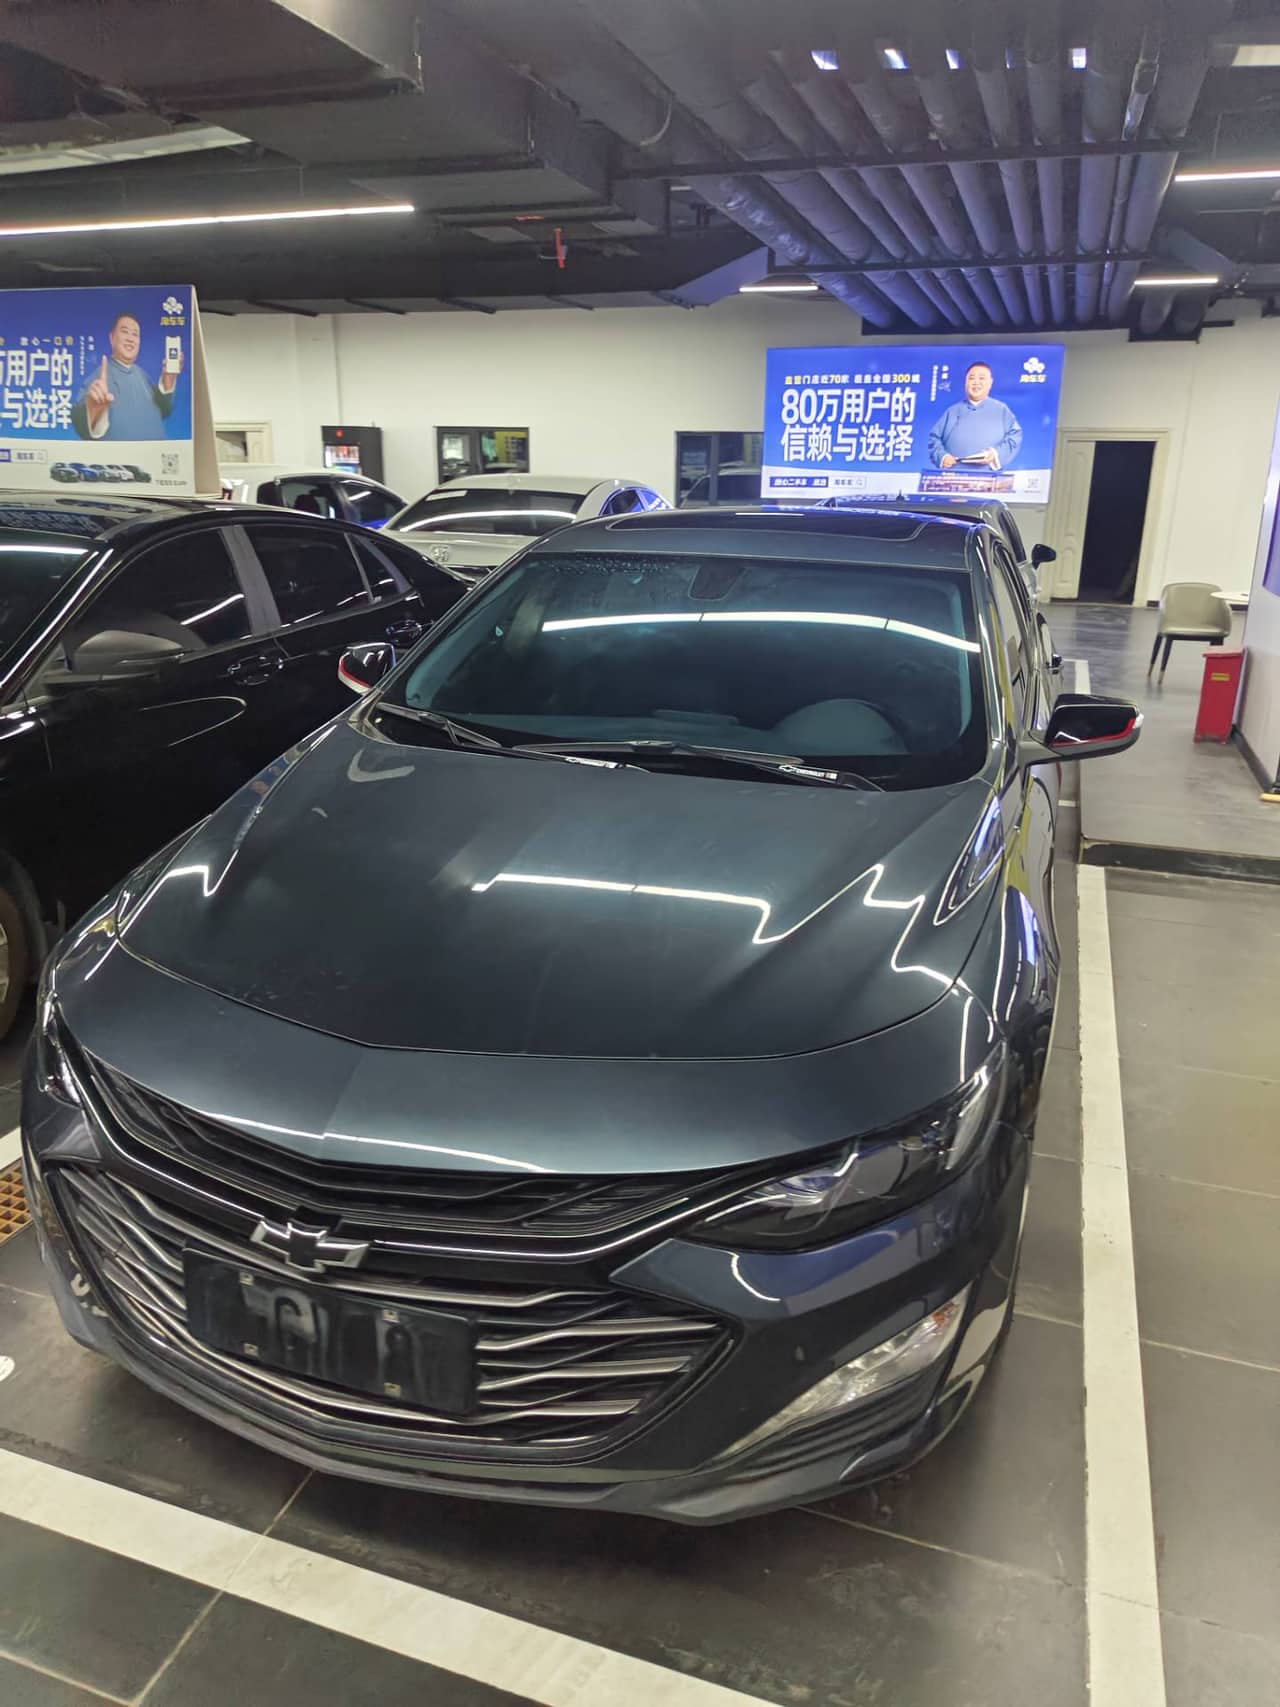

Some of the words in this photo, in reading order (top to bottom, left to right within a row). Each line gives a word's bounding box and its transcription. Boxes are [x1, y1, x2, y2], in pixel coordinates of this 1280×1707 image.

[0, 348, 73, 386] 用户的
[781, 386, 917, 424] 80万用户的
[781, 423, 914, 462] 信赖与选择
